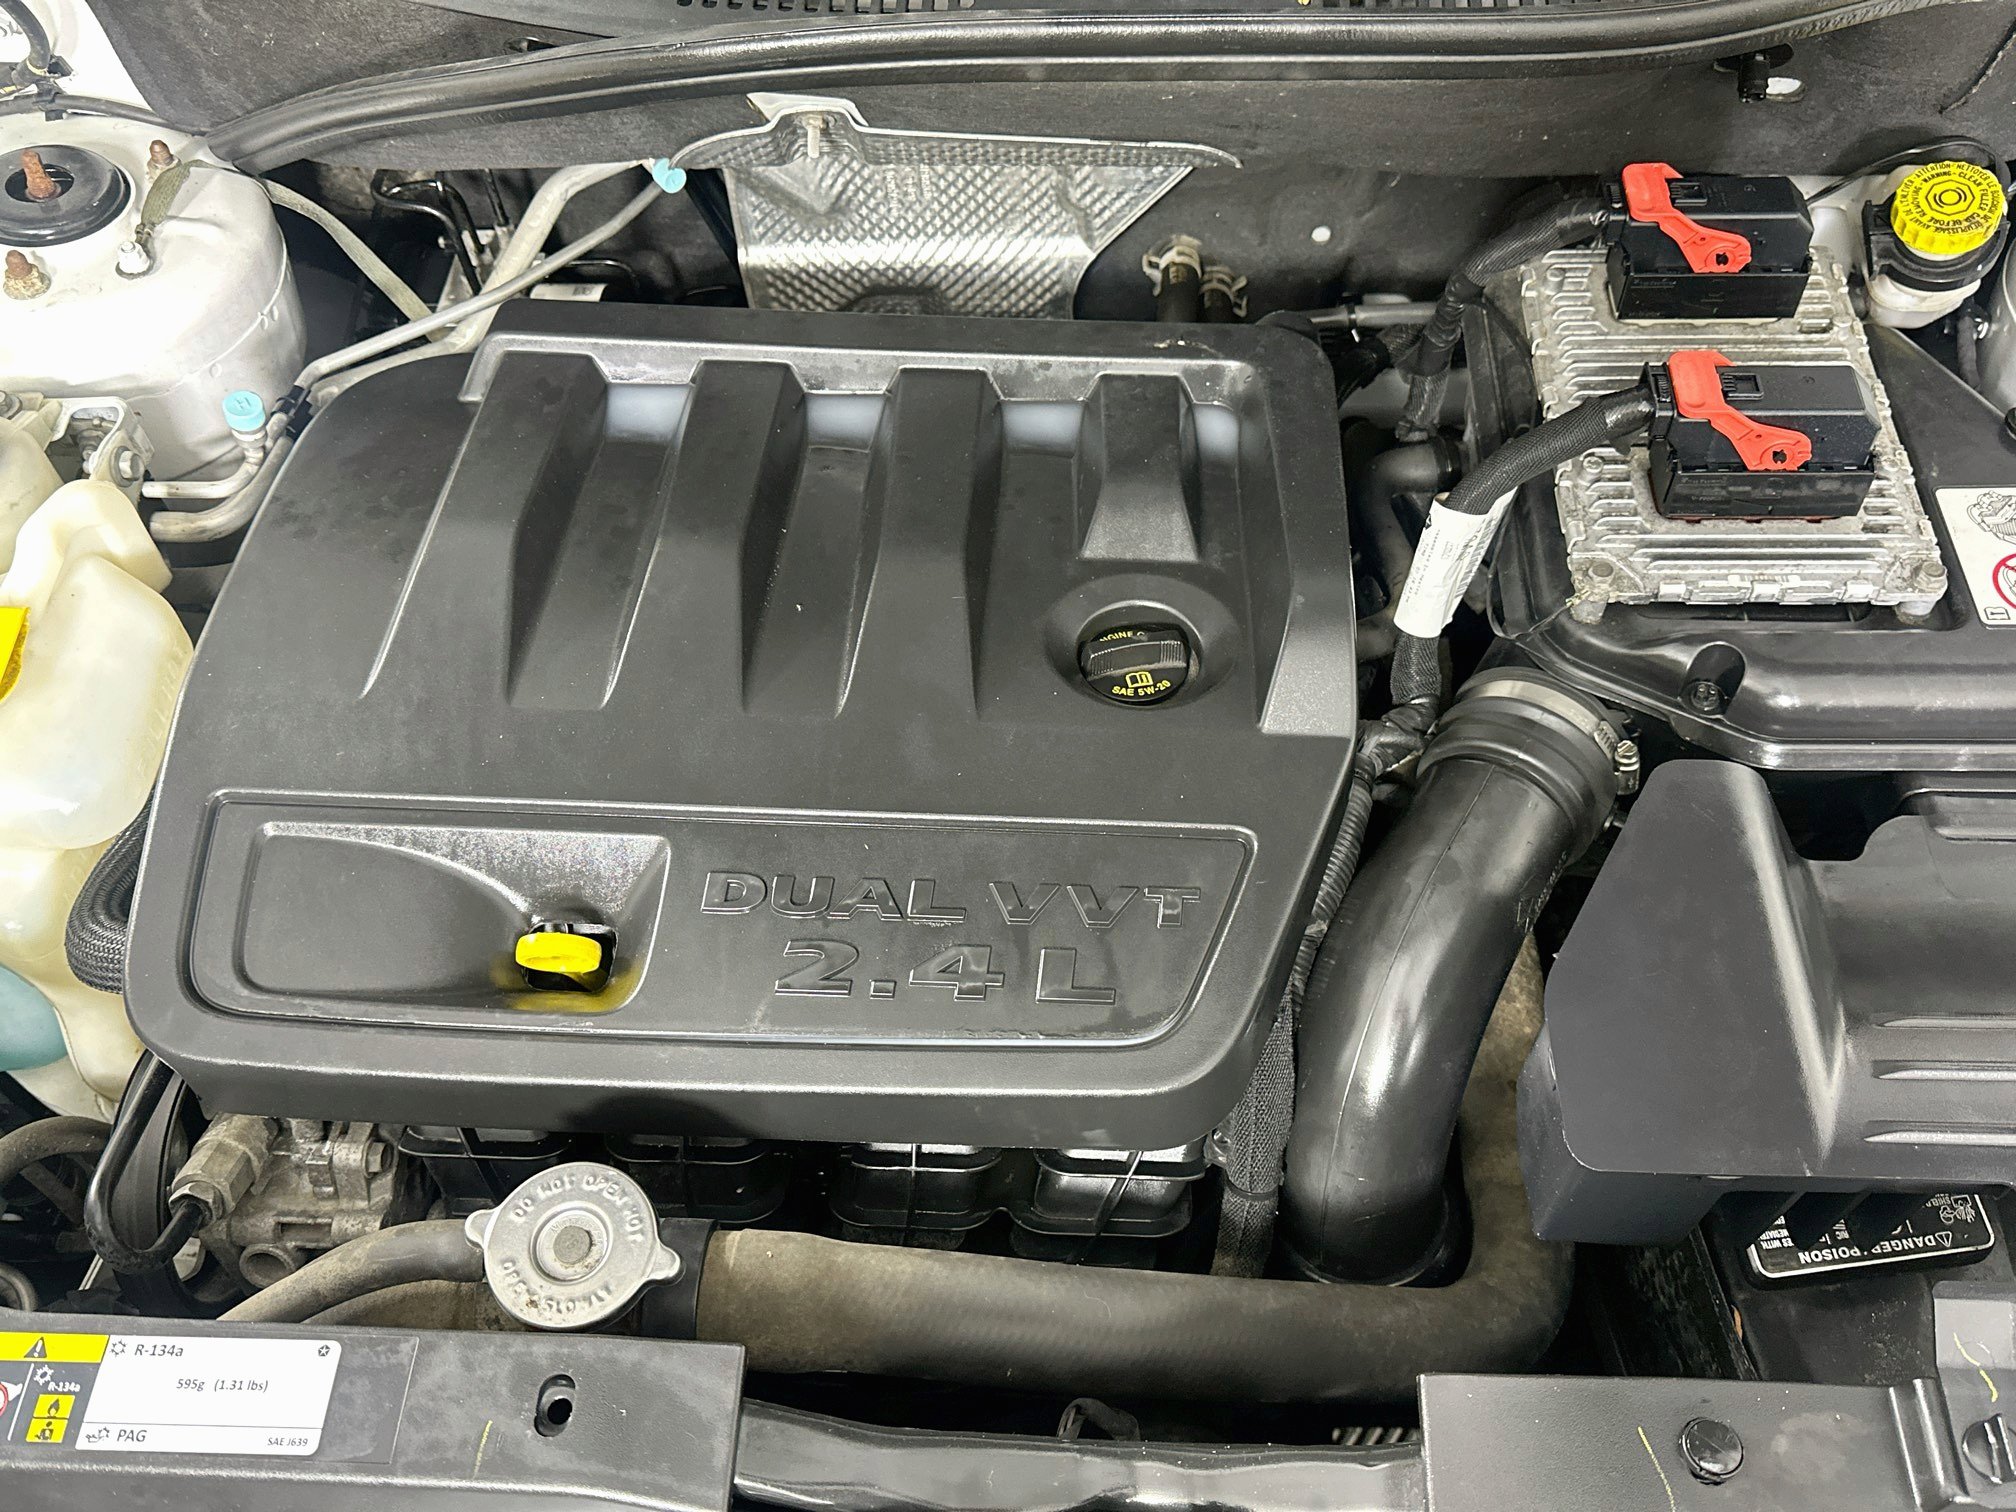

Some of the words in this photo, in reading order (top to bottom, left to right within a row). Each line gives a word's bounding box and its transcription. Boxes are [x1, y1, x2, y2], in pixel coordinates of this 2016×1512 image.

[1915, 163, 1951, 178] ATTENTION
[1956, 164, 1990, 181] NETTOYER
[1922, 171, 1952, 183] WARNING
[1958, 171, 1983, 187] CLEAN
[1927, 216, 1962, 227] BEFORE
[1112, 685, 1134, 696] SAE
[1138, 680, 1171, 696] 5W-20
[701, 871, 967, 924] DUAL
[988, 881, 1201, 929] VVT
[511, 1197, 534, 1222] DO
[536, 1173, 576, 1198] NOT
[583, 1174, 629, 1206] OPEN
[622, 1205, 646, 1243] HOT
[1760, 1240, 1782, 1249] WITH
[1797, 1246, 1861, 1264] POISON
[135, 1343, 184, 1358] R-134a
[176, 1378, 205, 1392] 595g
[214, 1379, 244, 1392] (1.31
[247, 1379, 269, 1392] lbs)
[117, 1428, 148, 1443] PAG
[267, 1436, 284, 1446] SAE
[285, 1437, 308, 1448] J639
